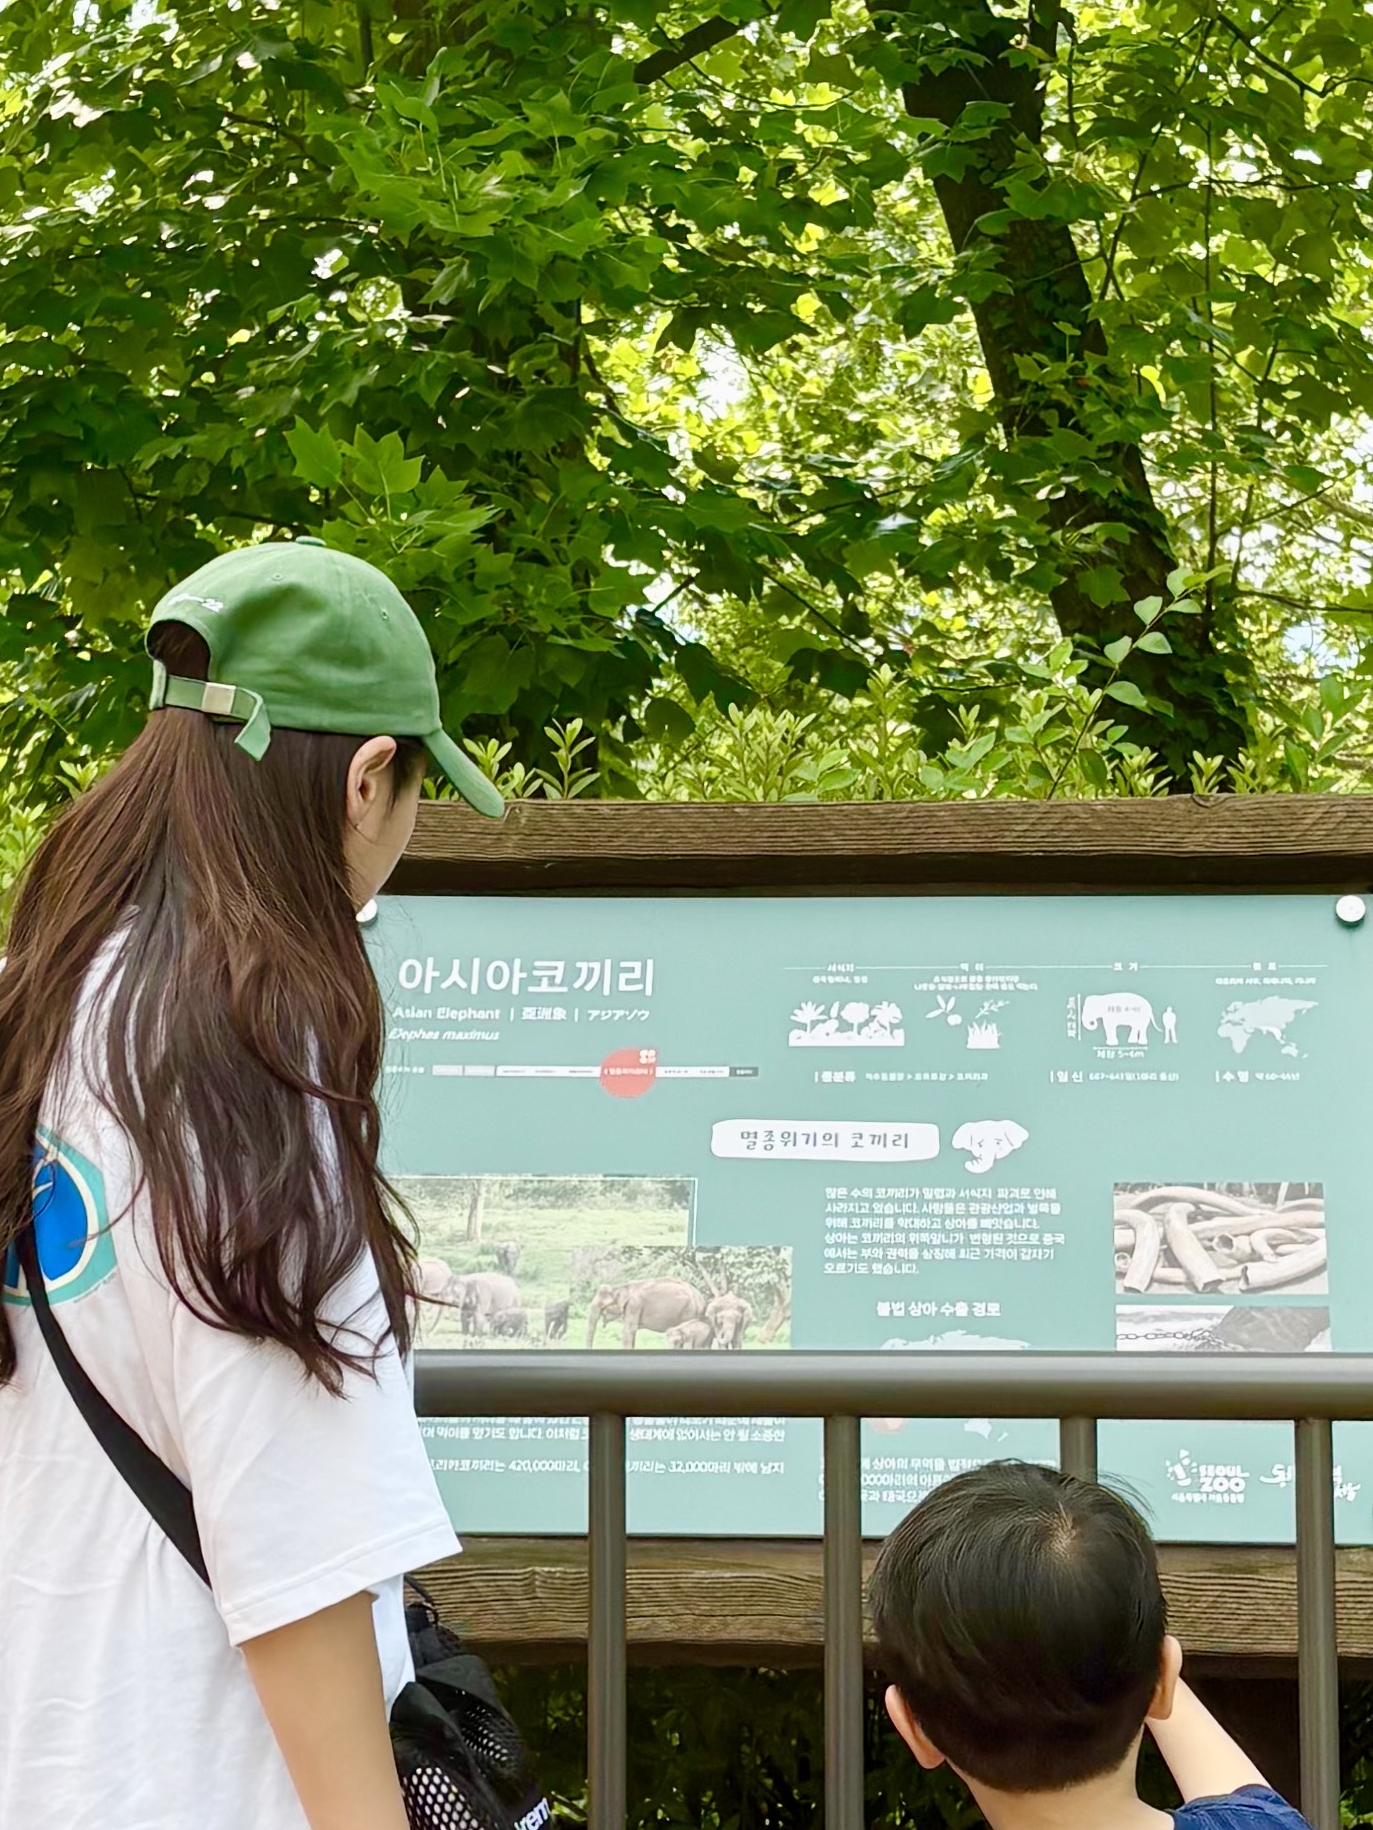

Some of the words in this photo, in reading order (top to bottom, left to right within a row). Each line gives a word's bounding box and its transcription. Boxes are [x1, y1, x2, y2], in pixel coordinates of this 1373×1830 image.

[398, 956, 655, 997] 아시아코끼리
[392, 1006, 433, 1019] Asian
[436, 1006, 501, 1022] Elephant
[442, 1029, 500, 1041] maximus
[740, 1130, 839, 1151] 멸종위기의
[850, 1132, 909, 1149] 코끼리
[874, 1187, 920, 1200] 코끼리가
[824, 1232, 858, 1245] 상아는
[861, 1232, 906, 1245] 코끼리의
[1006, 1232, 1040, 1245] 것으로
[824, 1247, 858, 1260] 에서는
[877, 1301, 905, 1317] 불법
[908, 1301, 937, 1317] 상아
[940, 1301, 969, 1317] 수출
[972, 1301, 1001, 1317] 경로
[1199, 1465, 1250, 1477] SEOUL
[1200, 1477, 1246, 1492] ZOO
